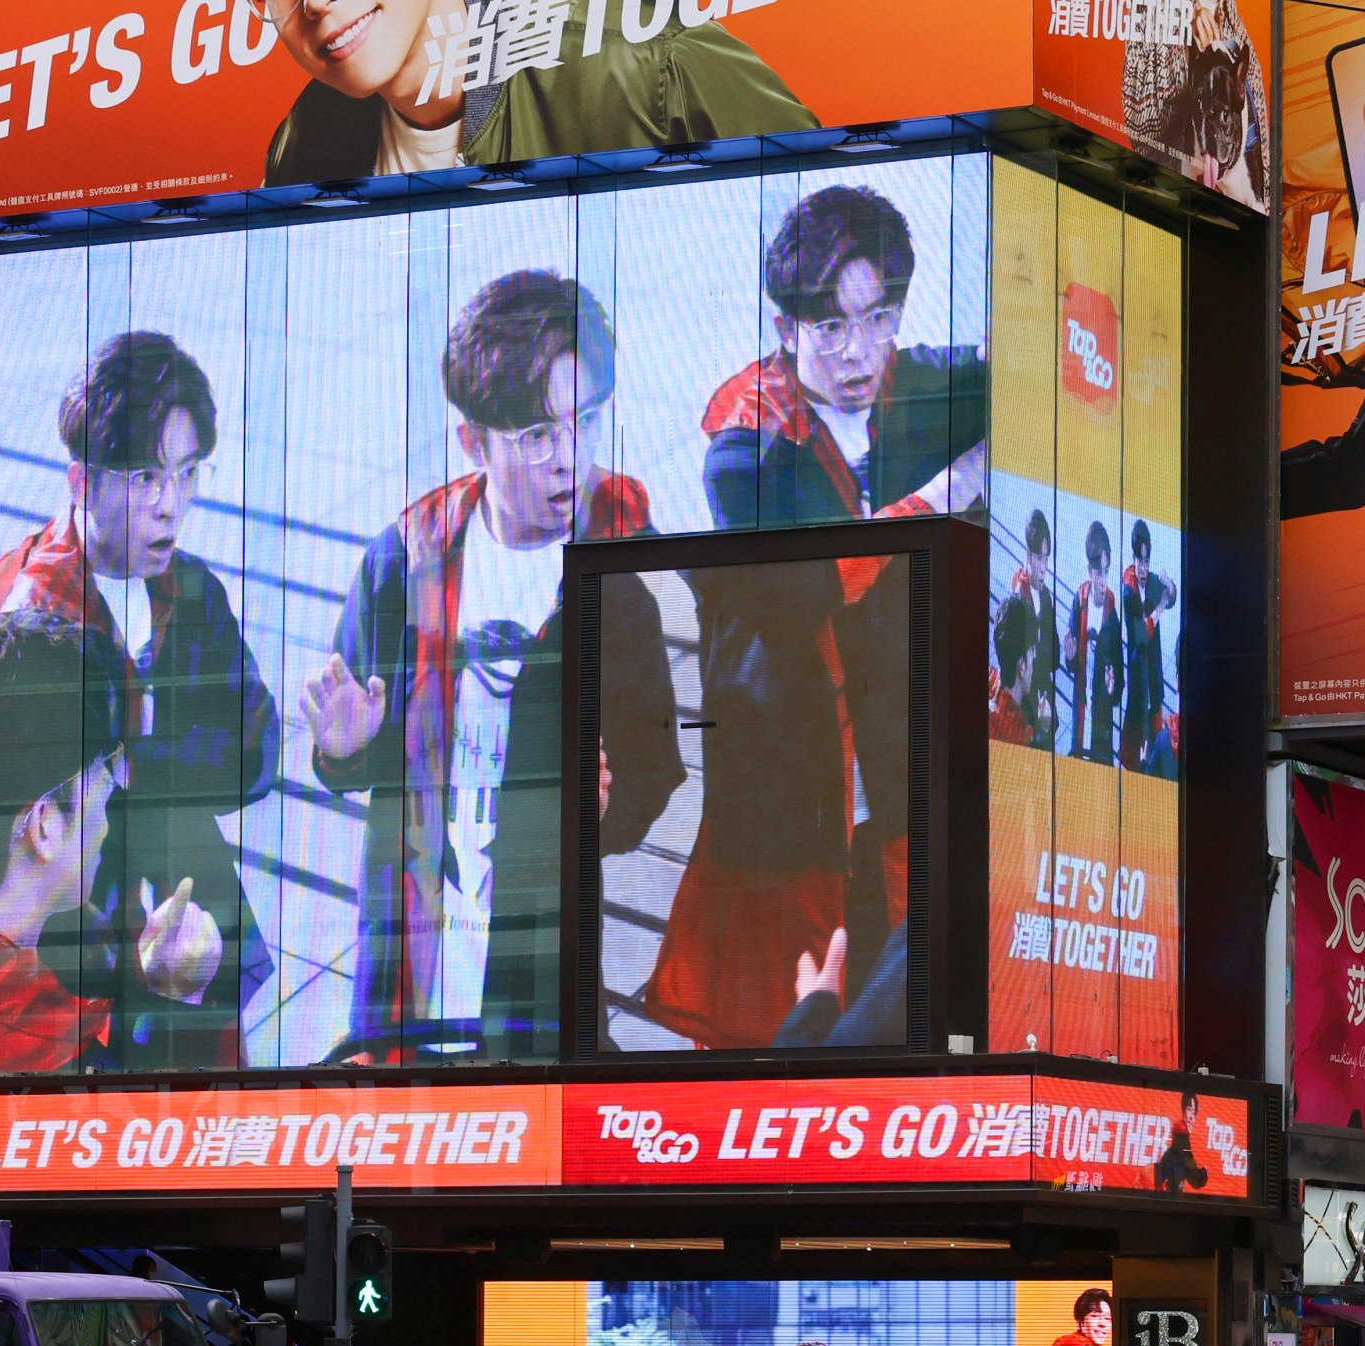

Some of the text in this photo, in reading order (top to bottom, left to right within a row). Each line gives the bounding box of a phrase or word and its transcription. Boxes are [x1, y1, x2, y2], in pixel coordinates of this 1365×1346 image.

[1294, 693, 1307, 702] Tap
[1036, 851, 1145, 920] LET'S GO
[1330, 1043, 1358, 1077] making
[117, 1116, 183, 1168] GO
[717, 1106, 866, 1160] LET'S
[879, 1105, 960, 1158] GO
